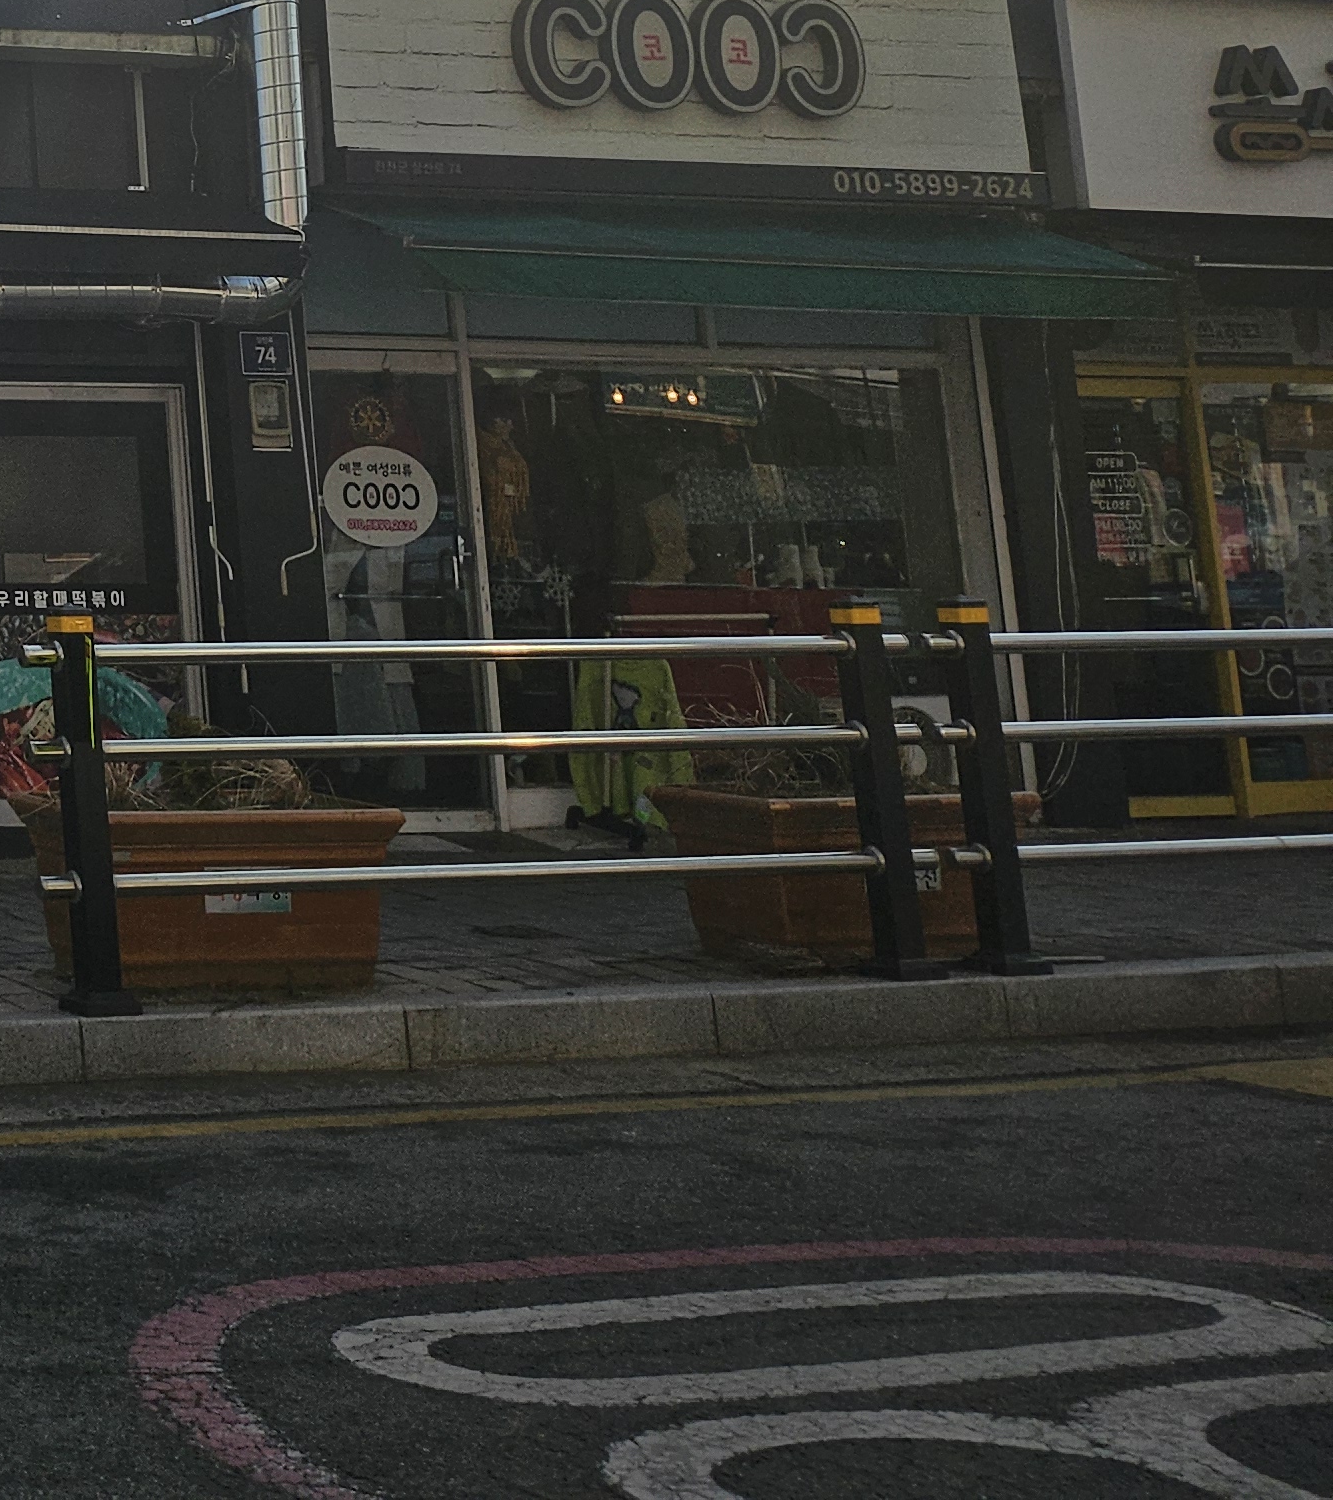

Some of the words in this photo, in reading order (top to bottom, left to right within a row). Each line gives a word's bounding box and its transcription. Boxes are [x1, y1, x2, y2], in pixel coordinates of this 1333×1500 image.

[640, 33, 665, 62] 코
[729, 38, 753, 66] 코
[833, 169, 1033, 201] 010-5899-2624
[255, 346, 278, 364] 74
[339, 461, 363, 476] 예쁜
[367, 463, 413, 477] 여성의류
[1096, 458, 1124, 468] OPEN
[1099, 500, 1131, 511] CLOSE
